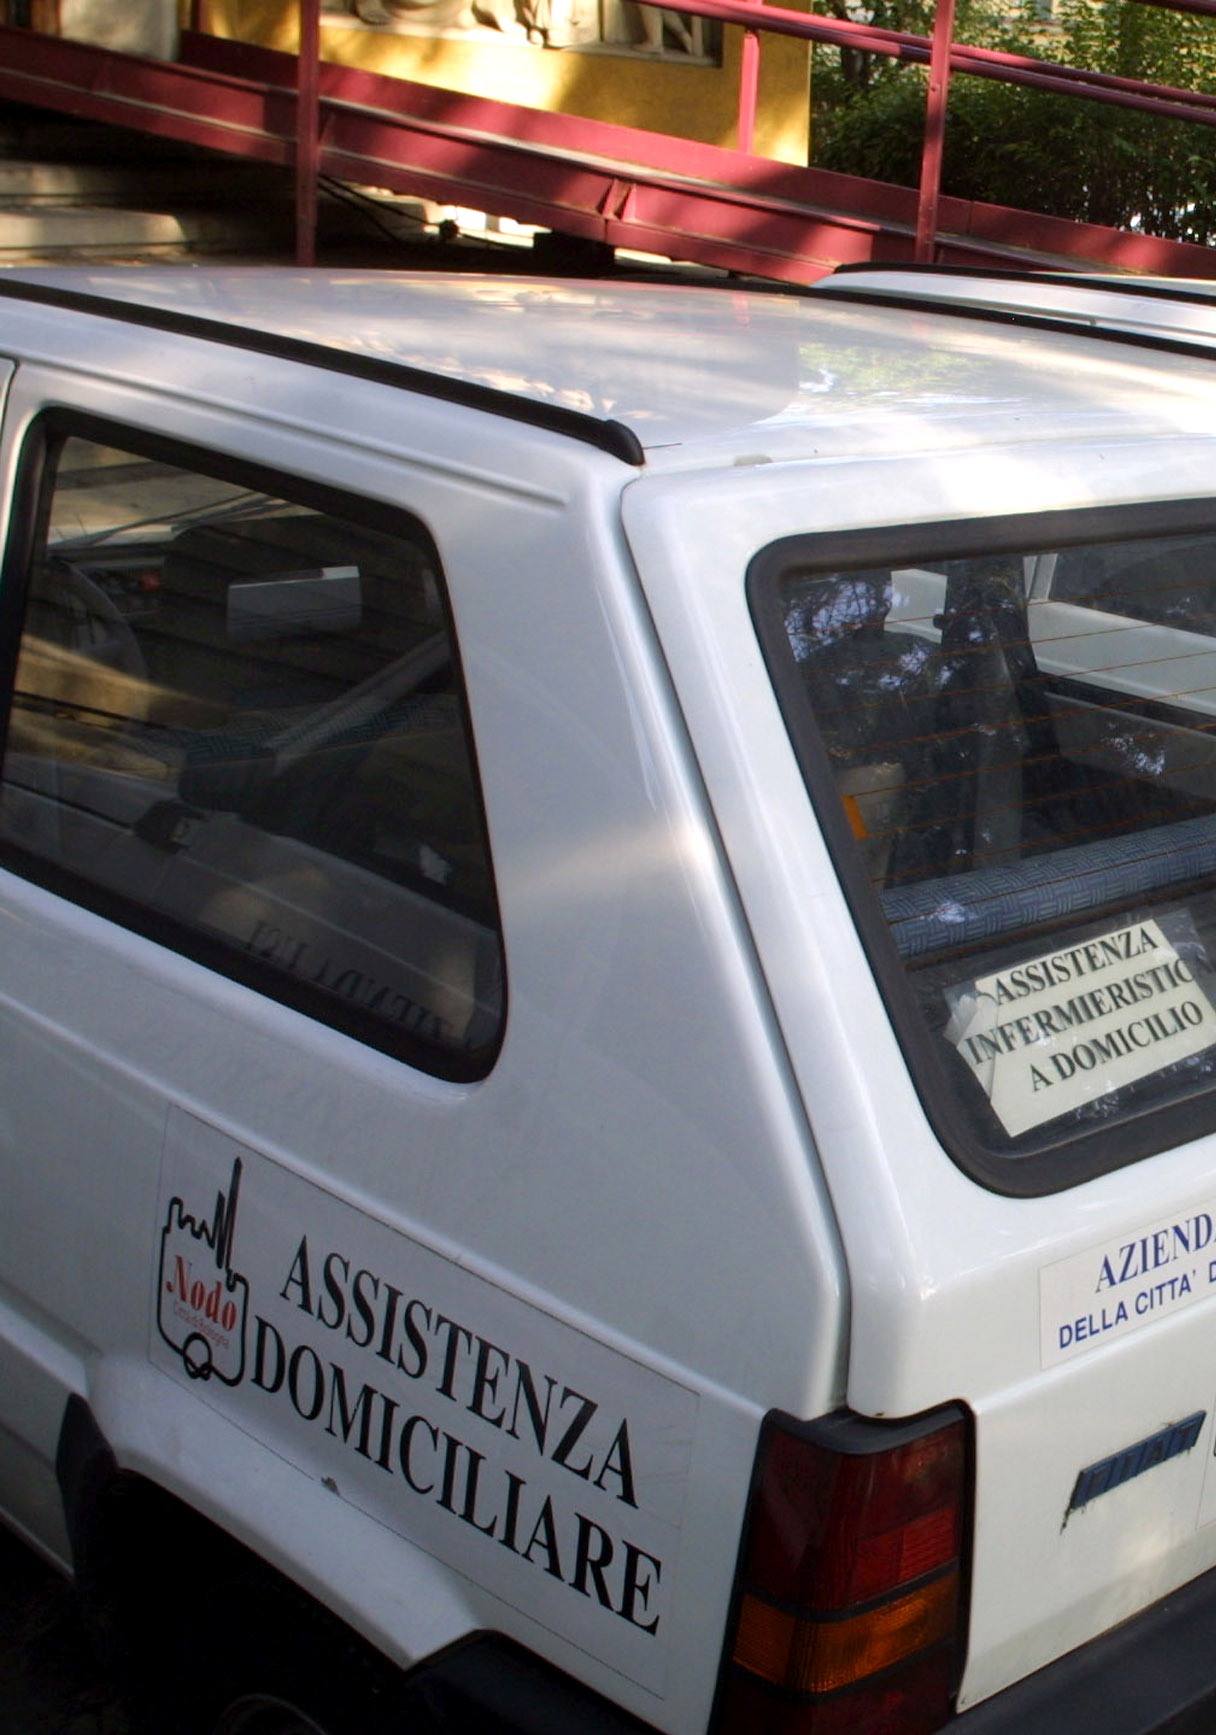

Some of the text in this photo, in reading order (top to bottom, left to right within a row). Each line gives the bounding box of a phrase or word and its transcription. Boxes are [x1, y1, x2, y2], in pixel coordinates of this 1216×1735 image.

[994, 927, 1159, 1006] ASSISTENZA
[1029, 999, 1204, 1093] A DOMICILIO
[165, 1254, 238, 1332] Nodo
[1059, 1304, 1129, 1349] DELLA
[1135, 1269, 1197, 1316] CITTA'
[280, 1234, 640, 1509] ASSISTENZA
[251, 1314, 663, 1637] DOMICILIARE
